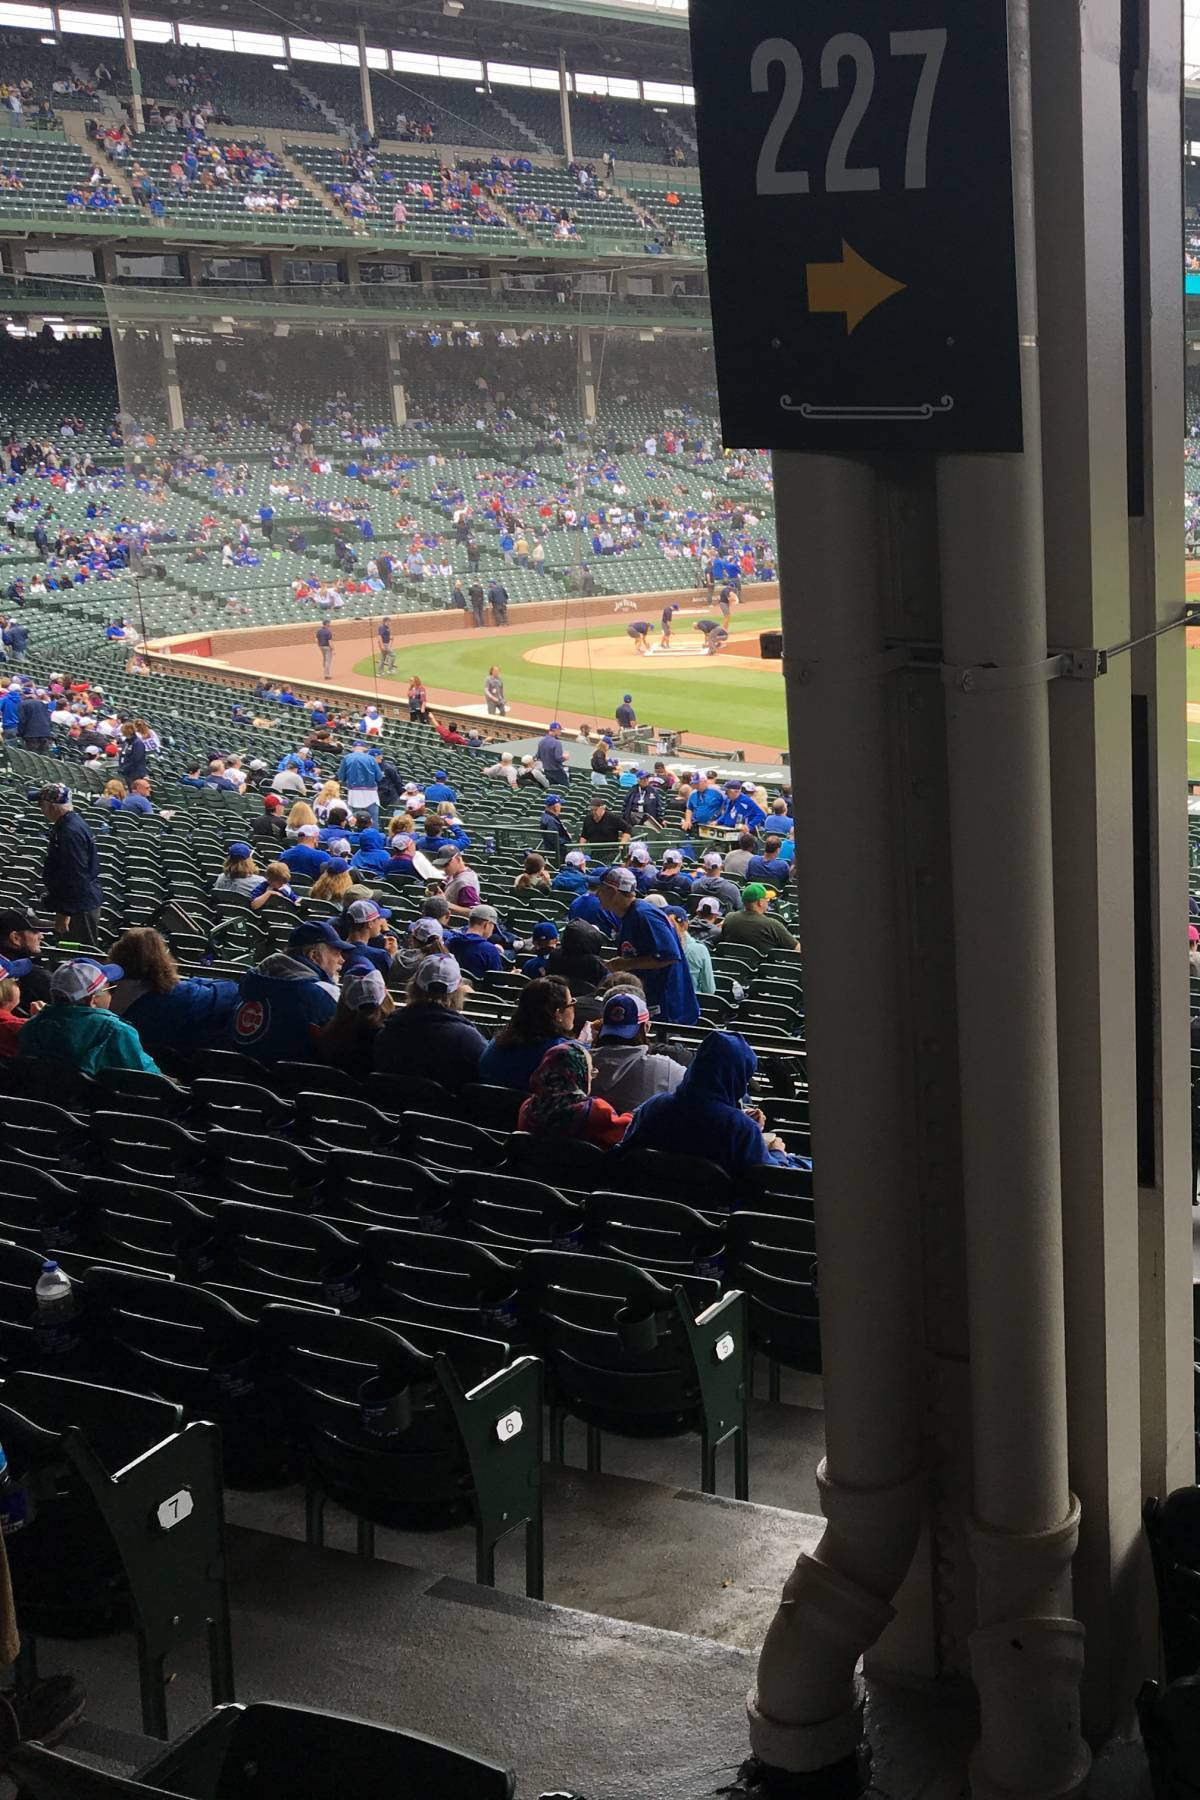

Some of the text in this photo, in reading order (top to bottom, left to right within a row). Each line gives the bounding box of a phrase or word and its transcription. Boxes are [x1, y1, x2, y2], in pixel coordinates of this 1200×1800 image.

[749, 27, 948, 196] 227
[506, 1418, 514, 1434] 6
[168, 1498, 179, 1519] 7
